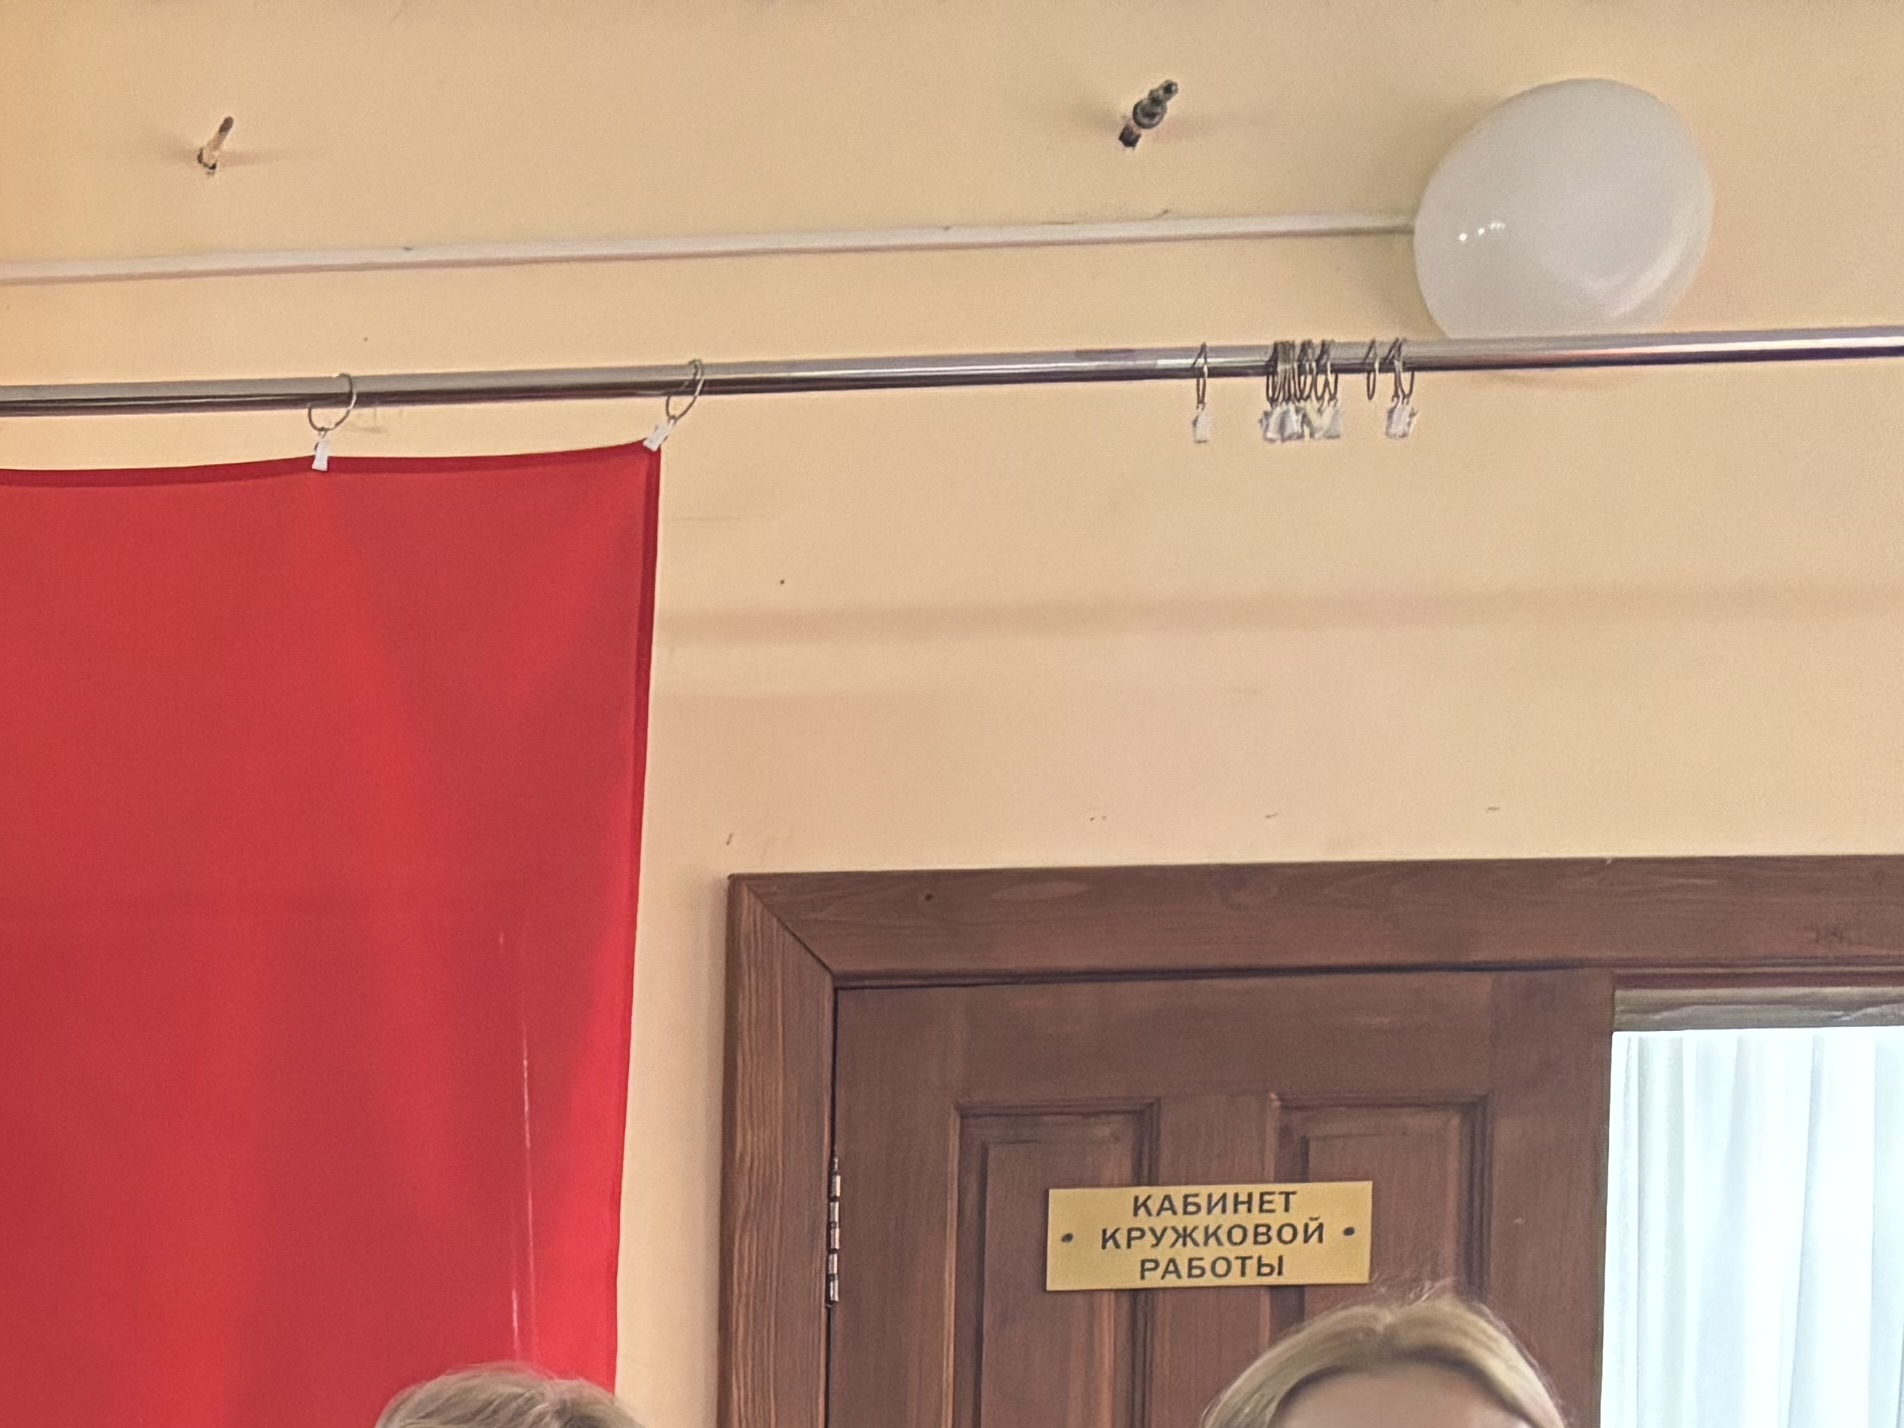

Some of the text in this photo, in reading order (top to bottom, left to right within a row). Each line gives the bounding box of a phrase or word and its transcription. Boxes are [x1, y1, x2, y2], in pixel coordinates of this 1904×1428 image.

[1133, 1191, 1297, 1217] КАБИНЕТ
[1101, 1216, 1325, 1250] КРУЖКОВОЙ
[1139, 1254, 1284, 1280] РАБОТЫ
